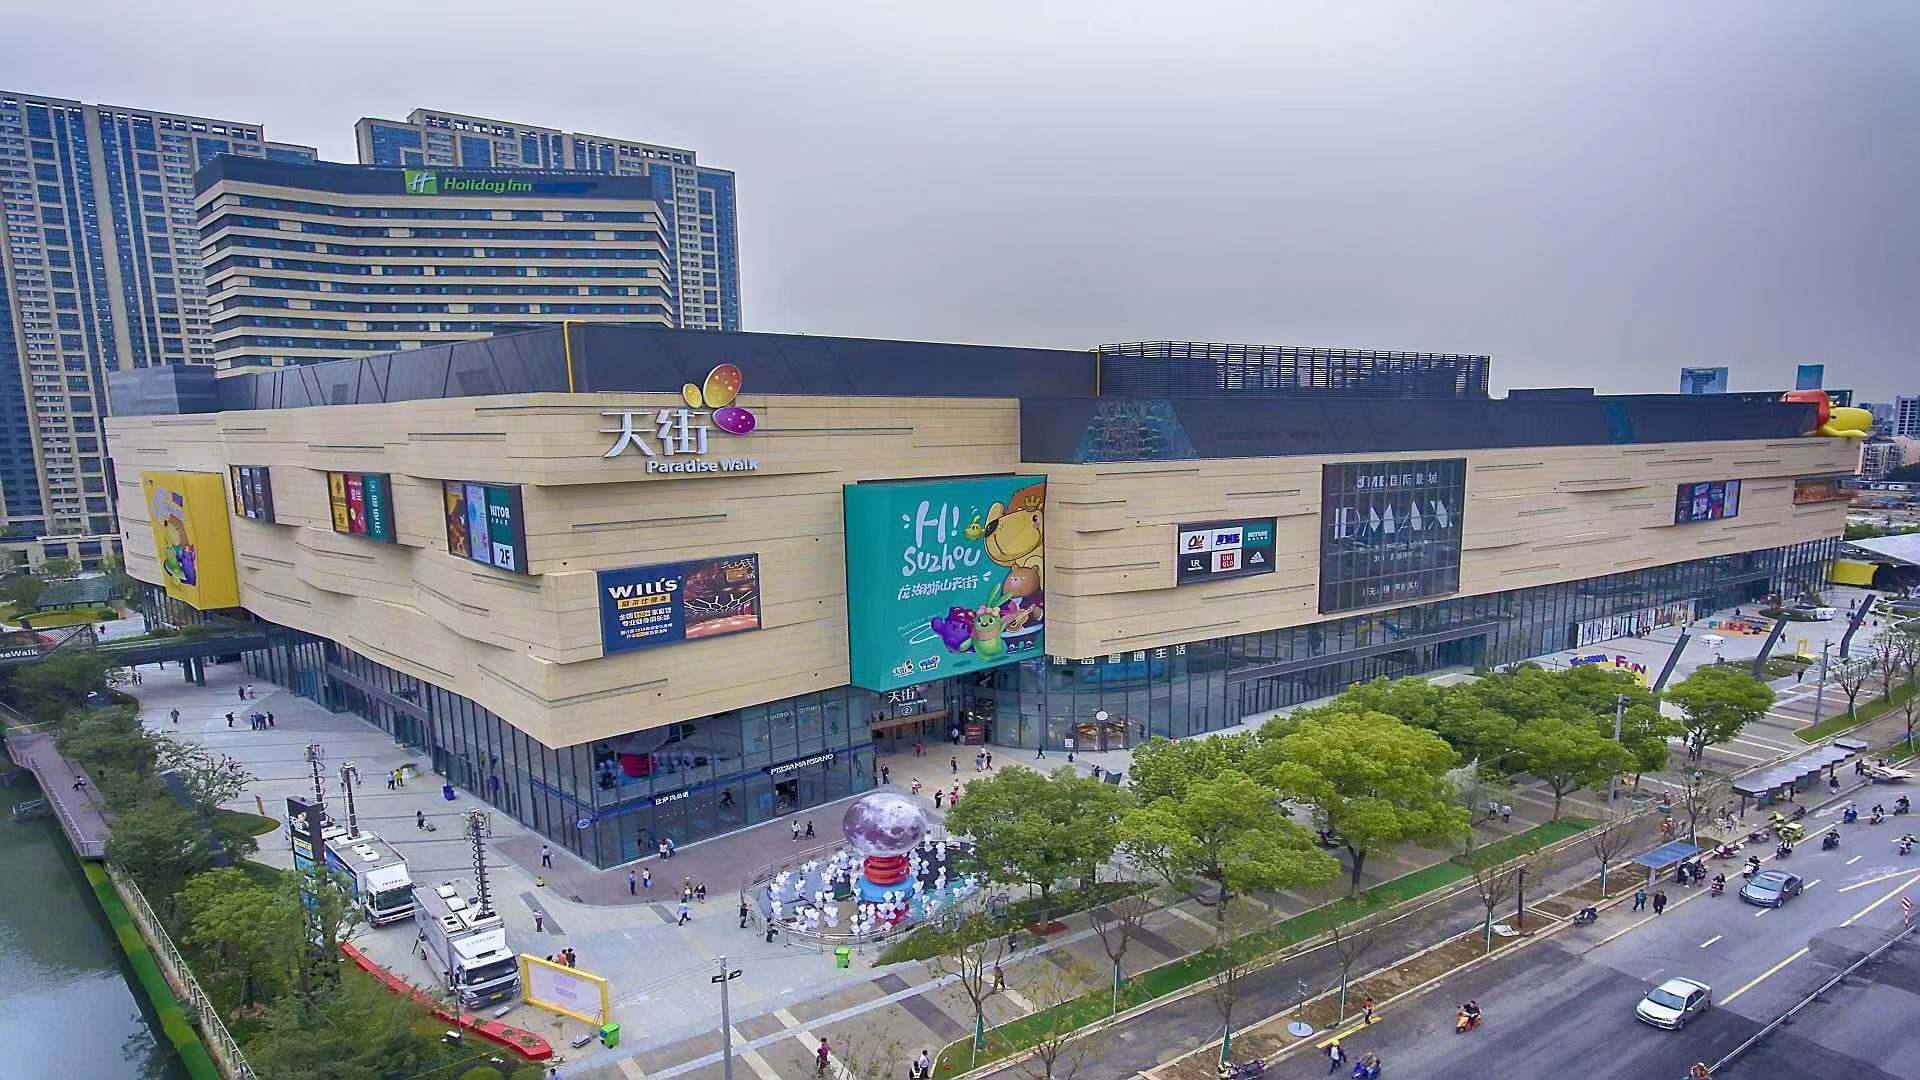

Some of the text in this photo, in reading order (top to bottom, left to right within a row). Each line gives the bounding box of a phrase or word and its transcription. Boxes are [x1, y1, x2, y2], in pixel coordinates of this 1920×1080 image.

[444, 177, 532, 193] Holiday Inn
[599, 409, 710, 458] 天街
[646, 457, 759, 473] Paradise Walk
[499, 548, 510, 565] 2F
[1222, 560, 1234, 568] QLO
[888, 688, 915, 704] 天街
